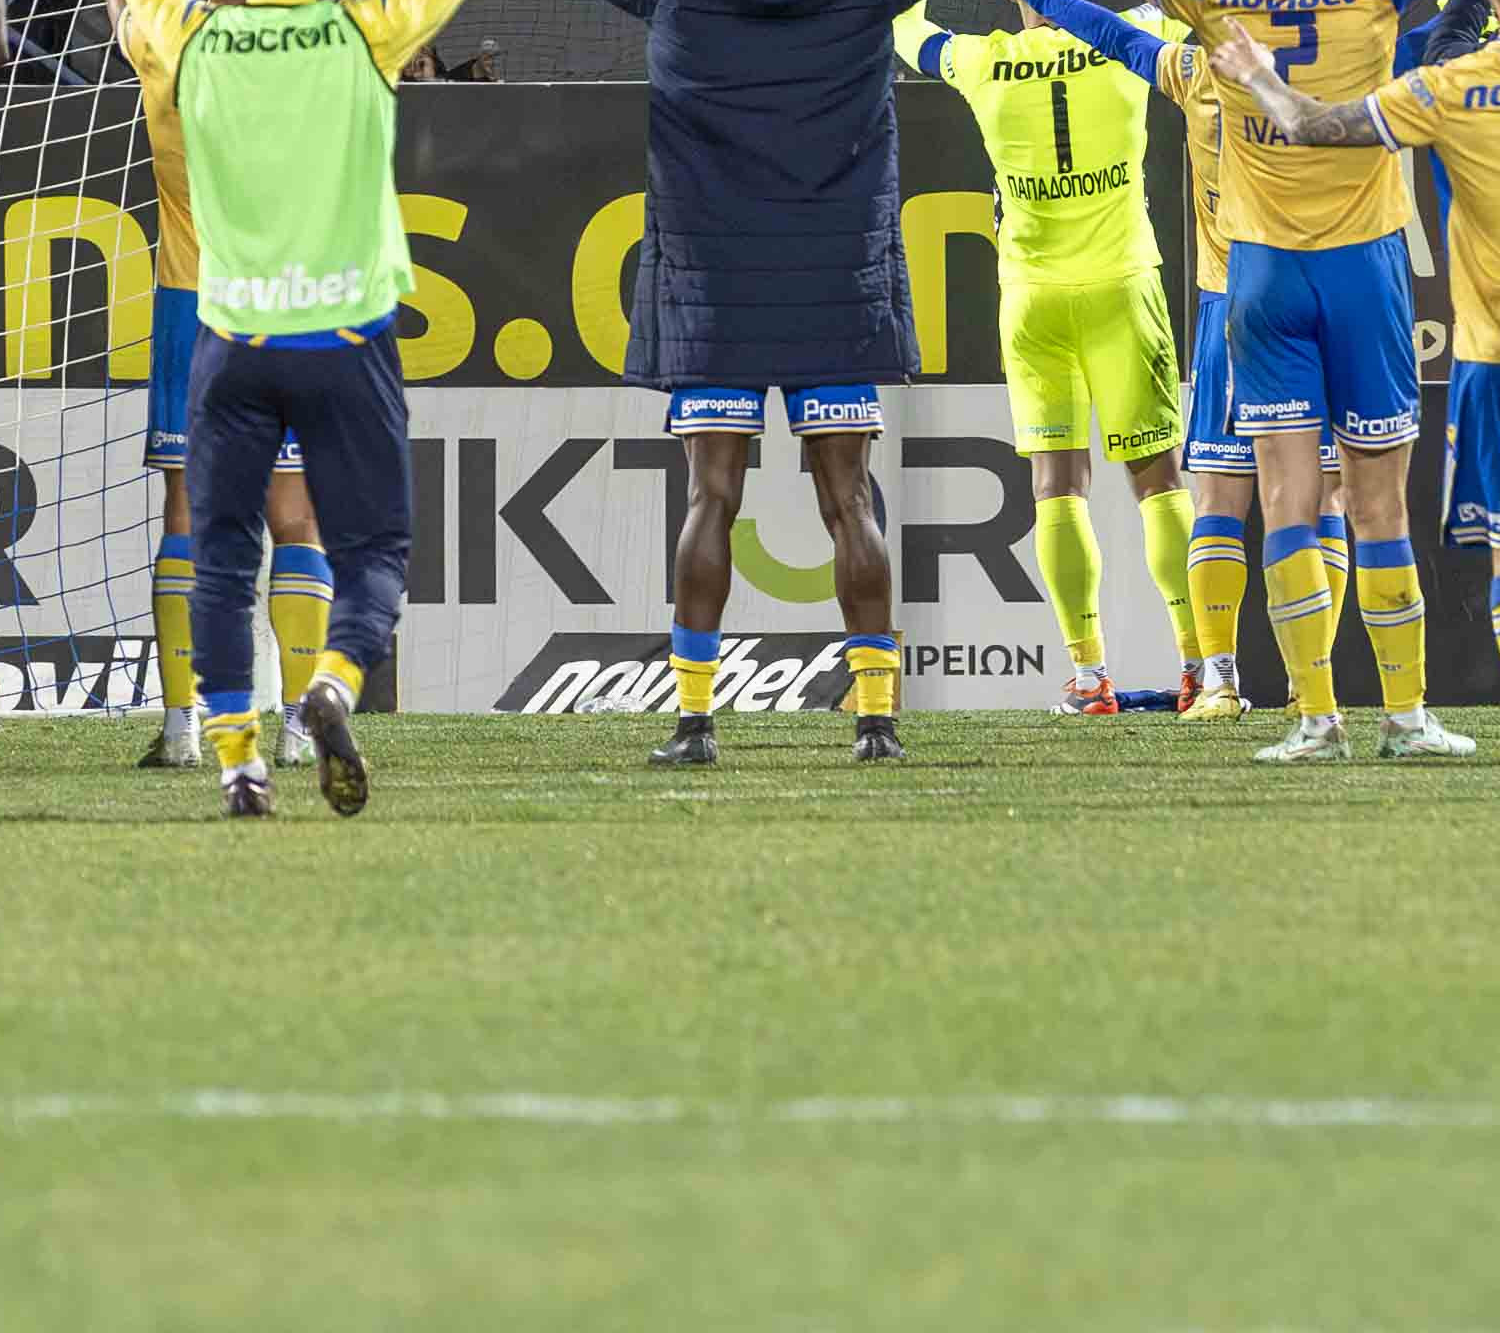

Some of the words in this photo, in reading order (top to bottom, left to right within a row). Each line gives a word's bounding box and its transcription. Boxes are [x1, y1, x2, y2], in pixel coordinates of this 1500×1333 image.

[201, 15, 348, 59] macron
[993, 46, 1110, 83] novibe
[1007, 161, 1132, 202] ΠΑΠΑΔΟΠΟΥΛΟΣ
